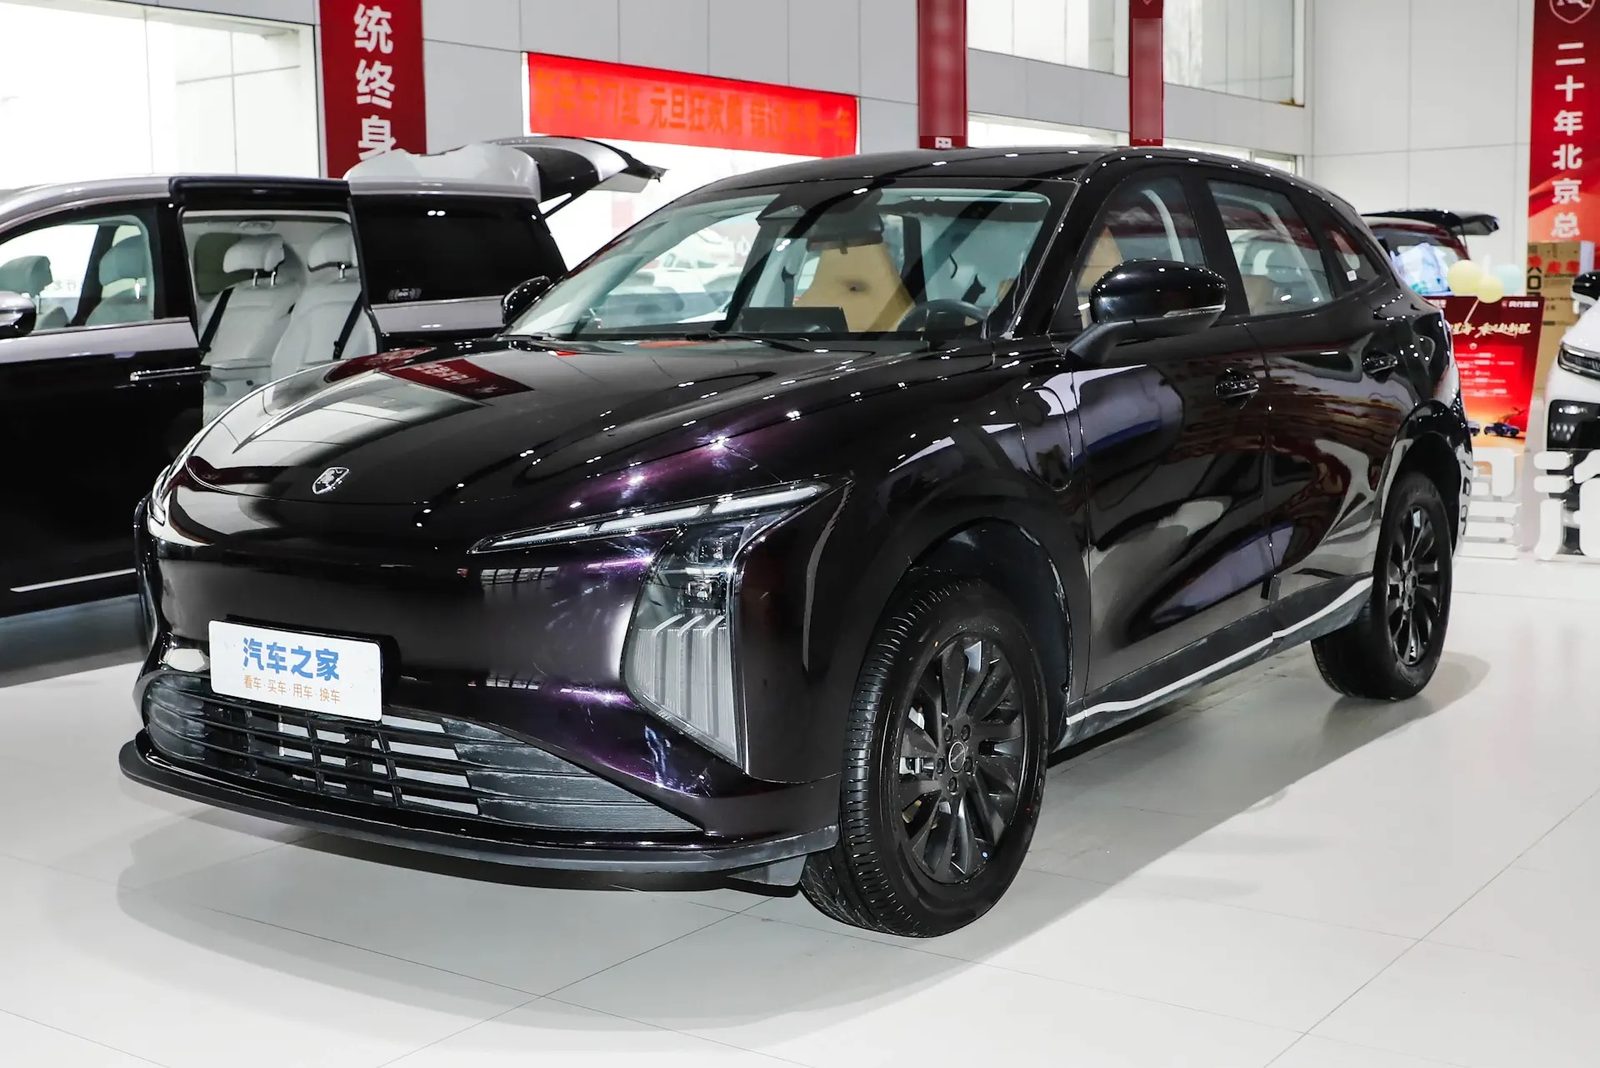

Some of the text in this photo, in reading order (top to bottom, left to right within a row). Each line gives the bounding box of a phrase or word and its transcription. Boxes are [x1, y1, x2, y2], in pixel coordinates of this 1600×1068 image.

[353, 3, 397, 161] 统终身
[1551, 42, 1586, 238] 二十年北京总
[243, 637, 340, 681] 汽车之家
